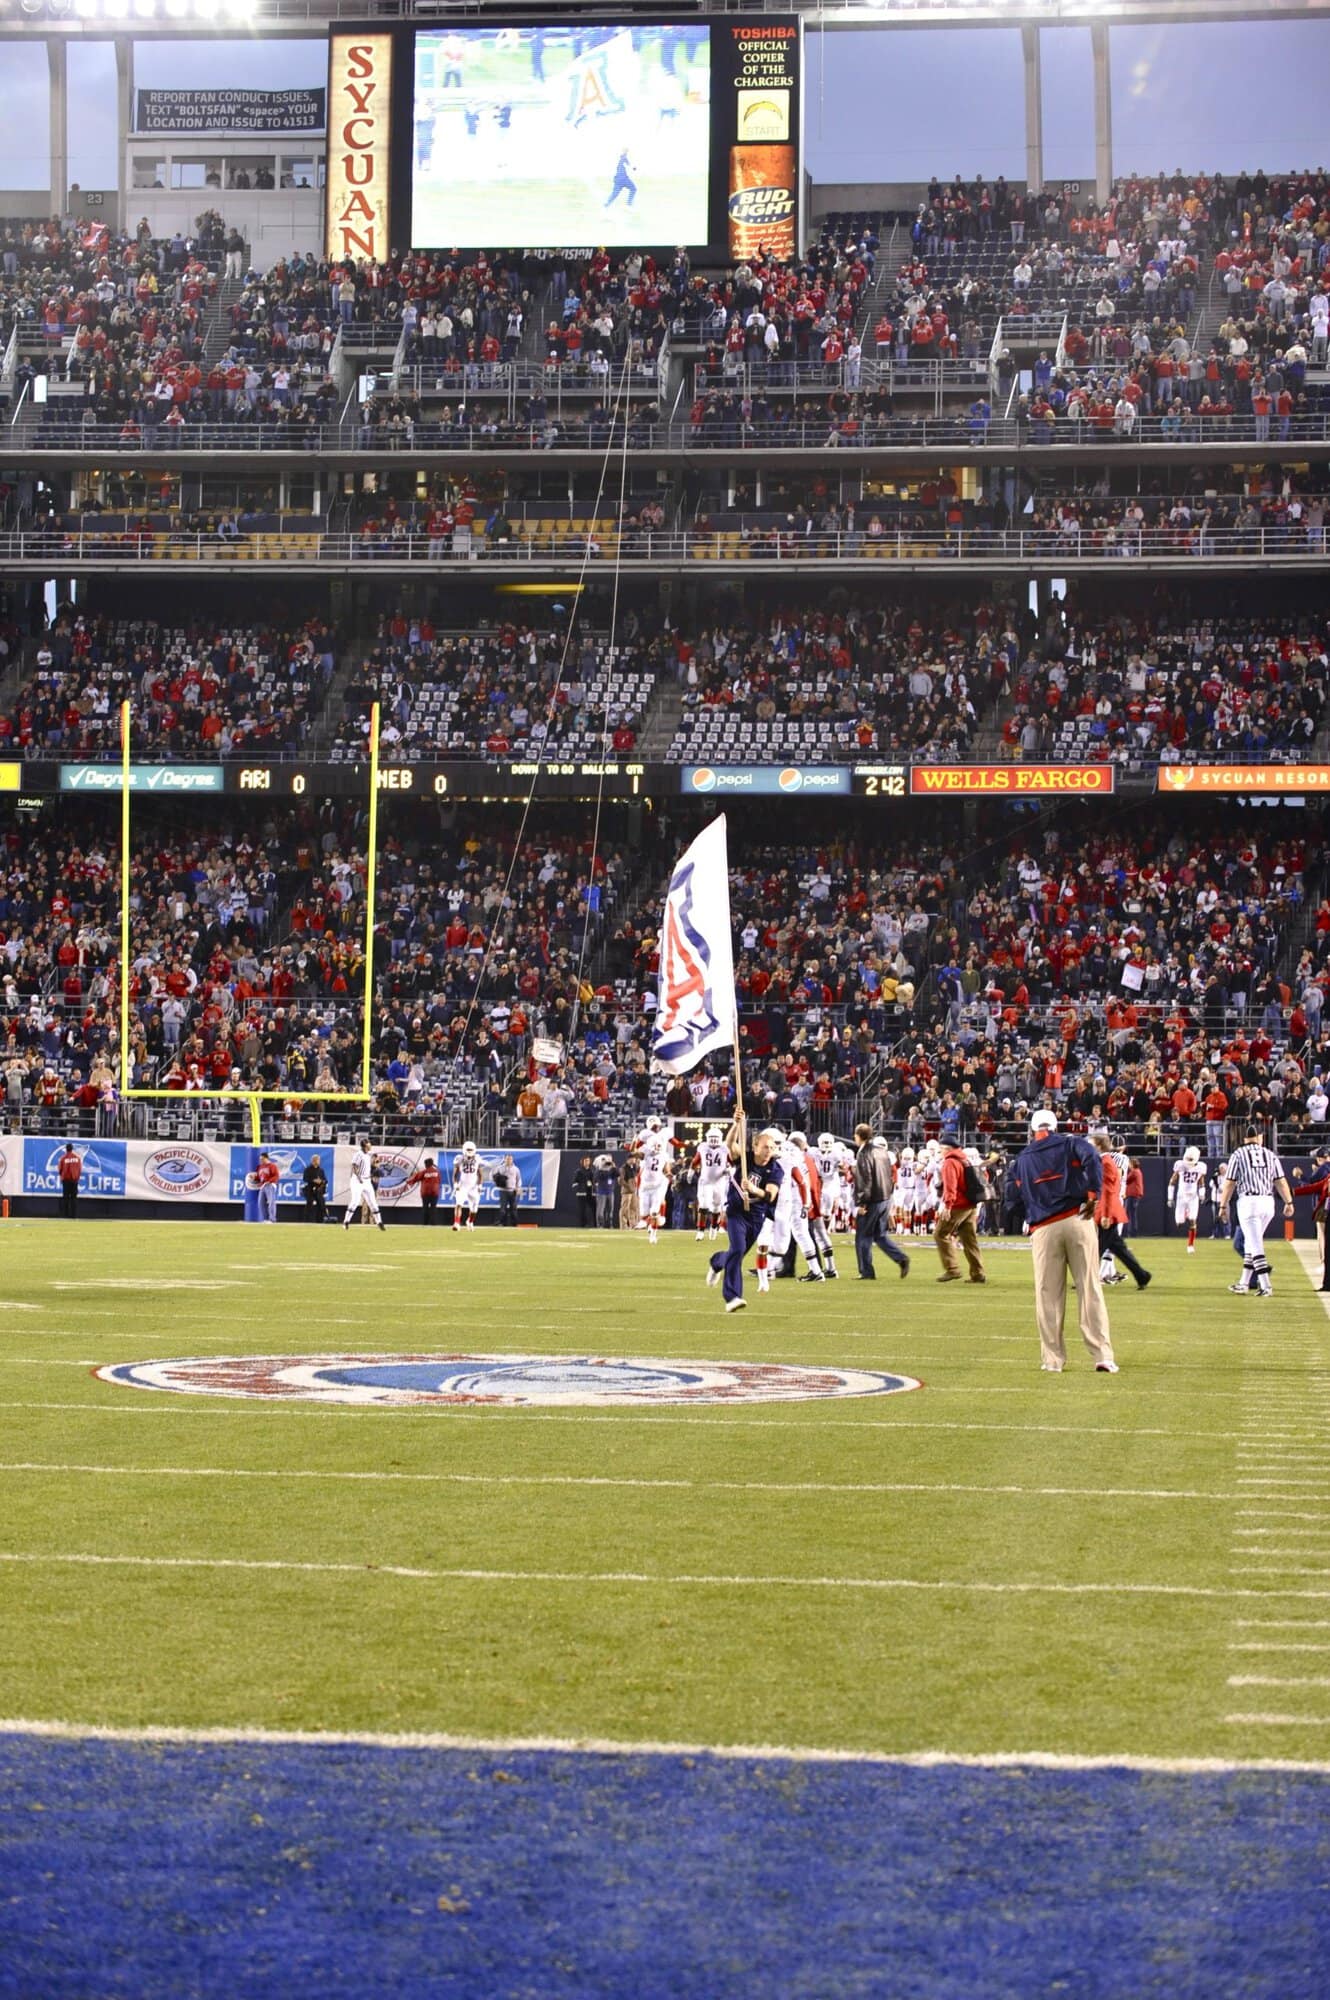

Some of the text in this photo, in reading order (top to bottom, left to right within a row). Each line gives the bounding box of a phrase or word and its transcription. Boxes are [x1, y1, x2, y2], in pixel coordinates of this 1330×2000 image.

[732, 27, 796, 39] TOSHIBA
[738, 41, 789, 51] OFFICIAL
[742, 53, 785, 63] COPIER
[742, 65, 785, 75] OF THE
[734, 77, 794, 87] CHARGERS
[150, 92, 313, 103] REPORT FAN CONDUCT ISSUES,
[145, 105, 172, 115] TEXT
[243, 107, 285, 117] <space>
[287, 103, 318, 114] YOUR
[147, 115, 315, 128] LOCATION AND ISSUE TO 41513
[338, 45, 377, 257] SYCUAN
[1063, 183, 1080, 193] 20
[87, 193, 103, 204] 23
[740, 189, 789, 204] BUD
[732, 200, 795, 217] LIGHT
[511, 764, 539, 775] DOWN
[547, 764, 575, 775] TO GO
[162, 771, 215, 788] Degree
[292, 774, 305, 794] 0
[376, 769, 413, 789] NEB
[434, 774, 447, 794] 0
[717, 773, 753, 787] pepsi
[803, 773, 840, 787] pepsi
[921, 770, 1102, 789] WELLS FARGO
[1201, 772, 1266, 784] SYCUAN
[27, 1172, 121, 1191] PACIC LIFE
